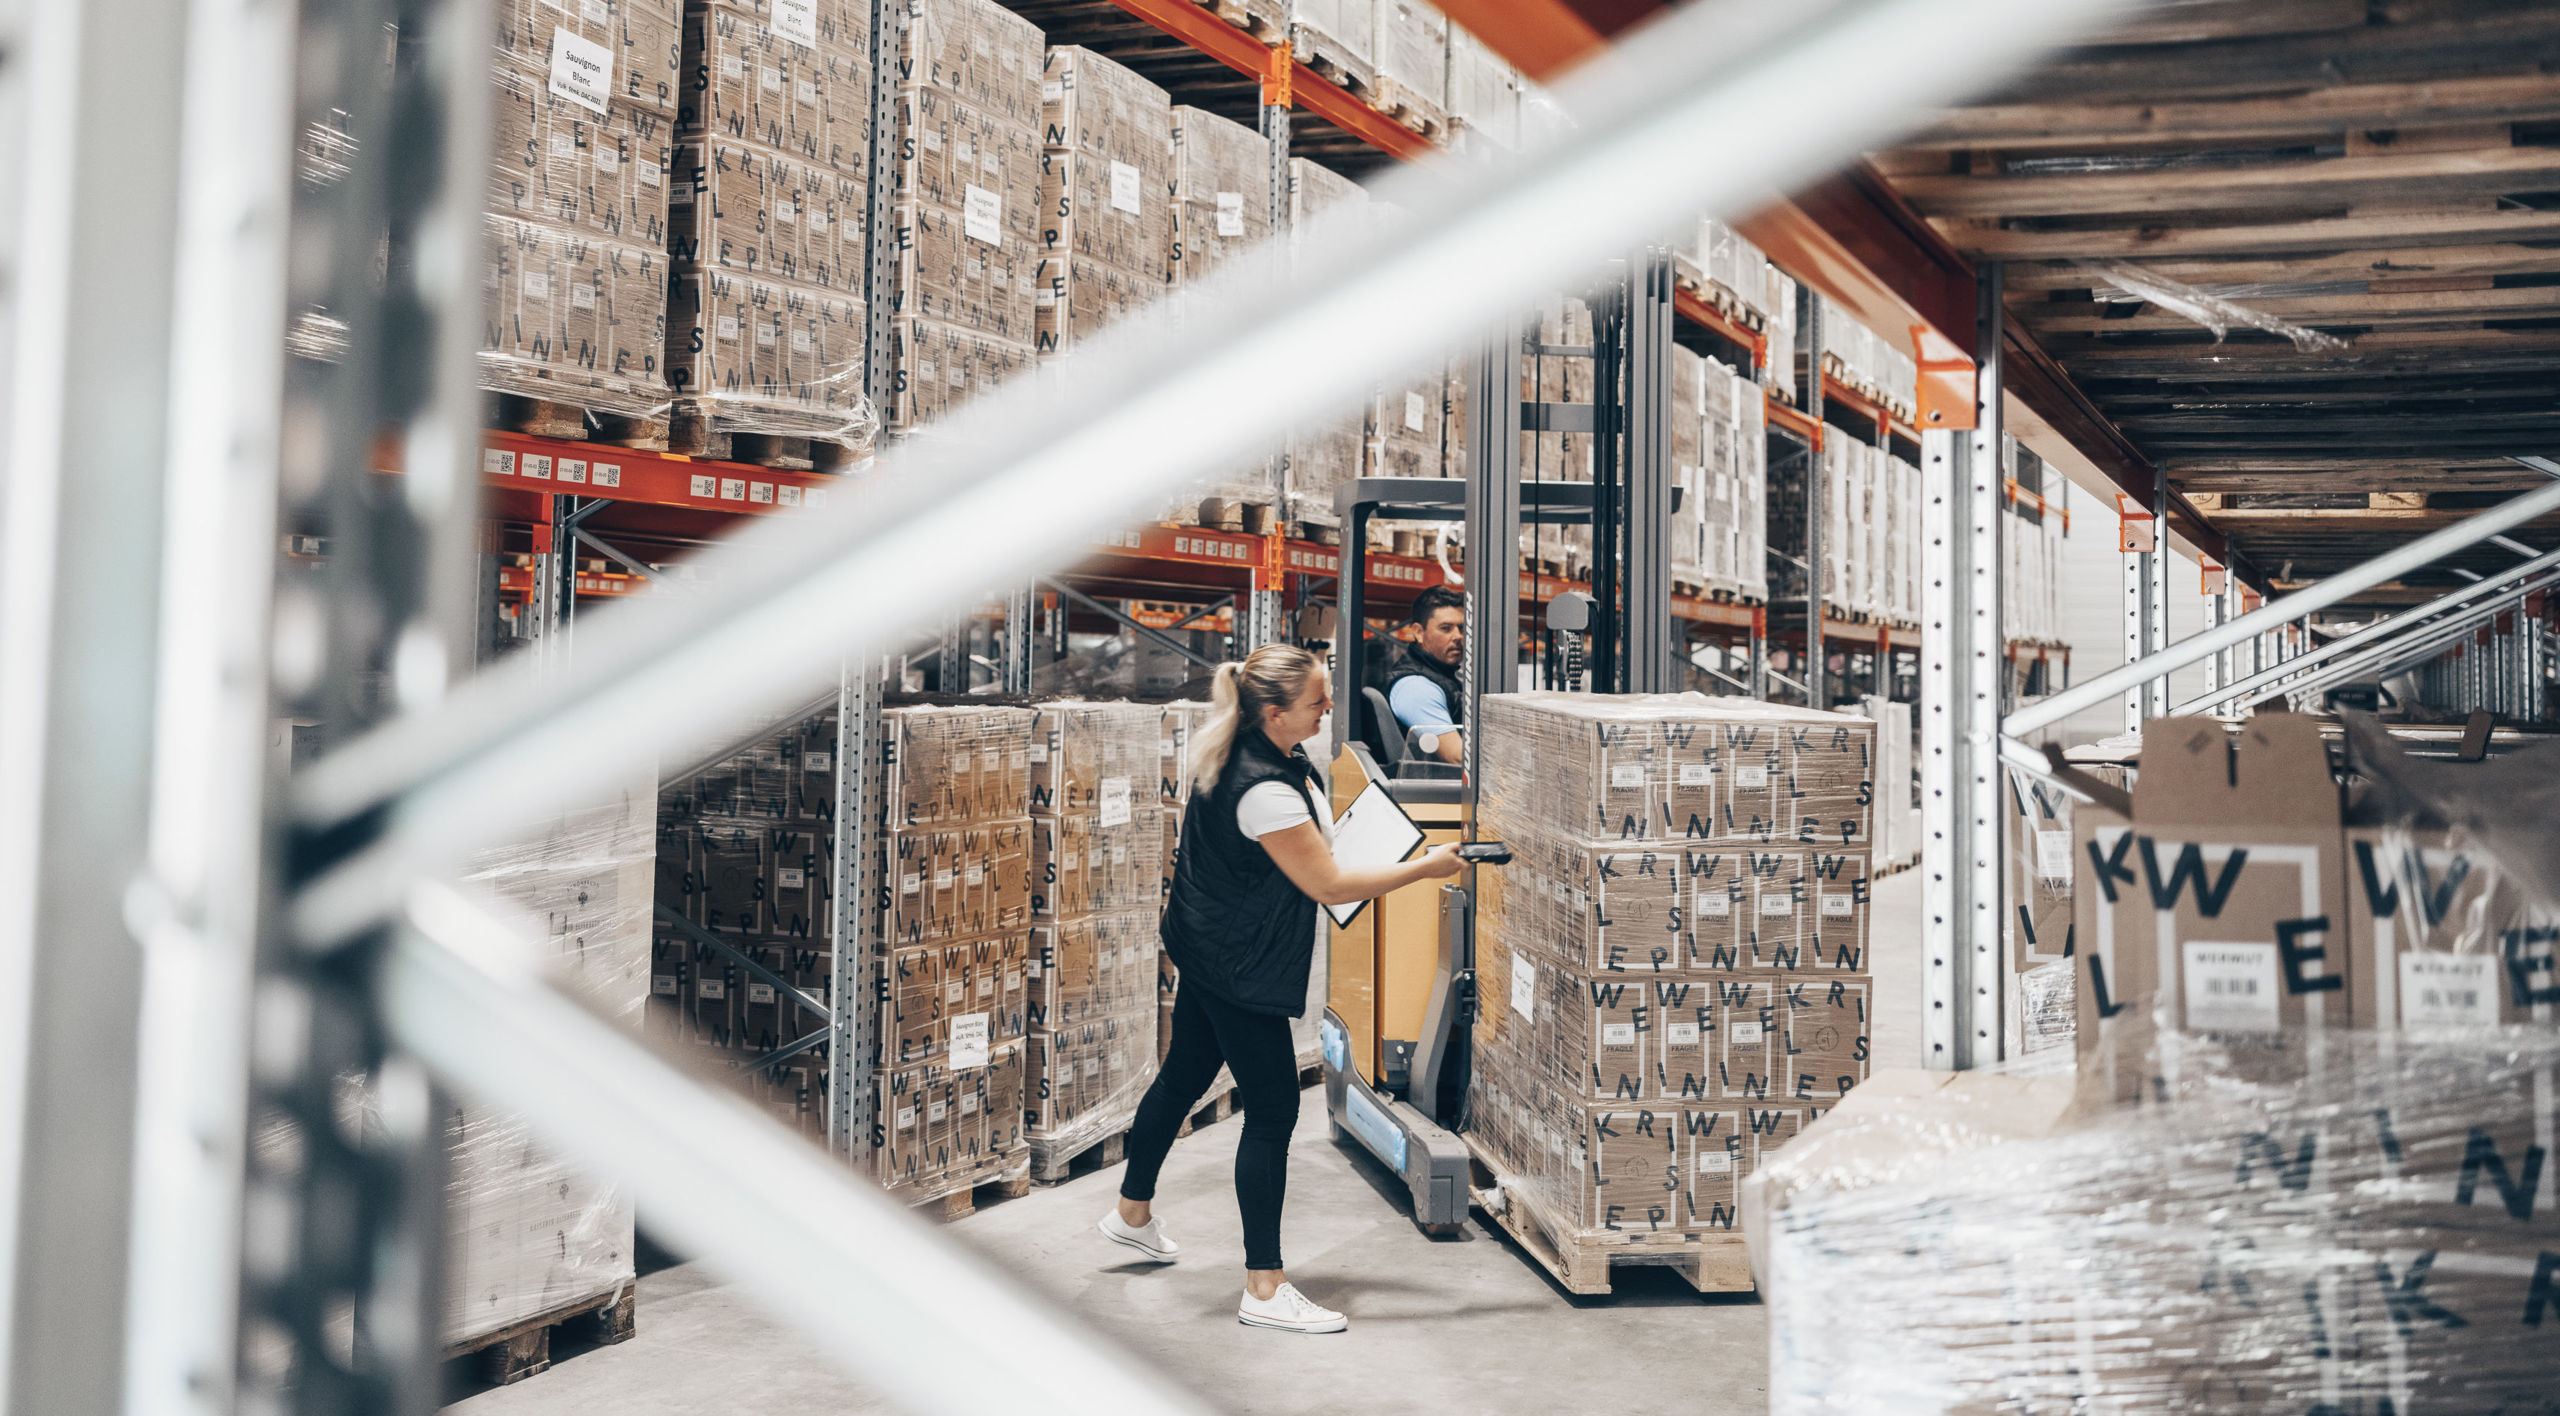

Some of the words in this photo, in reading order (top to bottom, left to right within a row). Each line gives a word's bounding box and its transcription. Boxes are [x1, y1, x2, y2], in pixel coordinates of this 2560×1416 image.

[565, 50, 601, 74] Sauvignon
[572, 71, 591, 87] Blanc
[1463, 591, 1473, 789] JUNGHEINRICH
[1611, 786, 1639, 794] FRAGILE
[1677, 785, 1705, 793] FRAGILE
[1764, 915, 1792, 923] FRAGILE
[1606, 1044, 1633, 1052] FRAGILE
[1671, 1044, 1699, 1052] FRAGILE
[1733, 1044, 1761, 1052] FRAGILE
